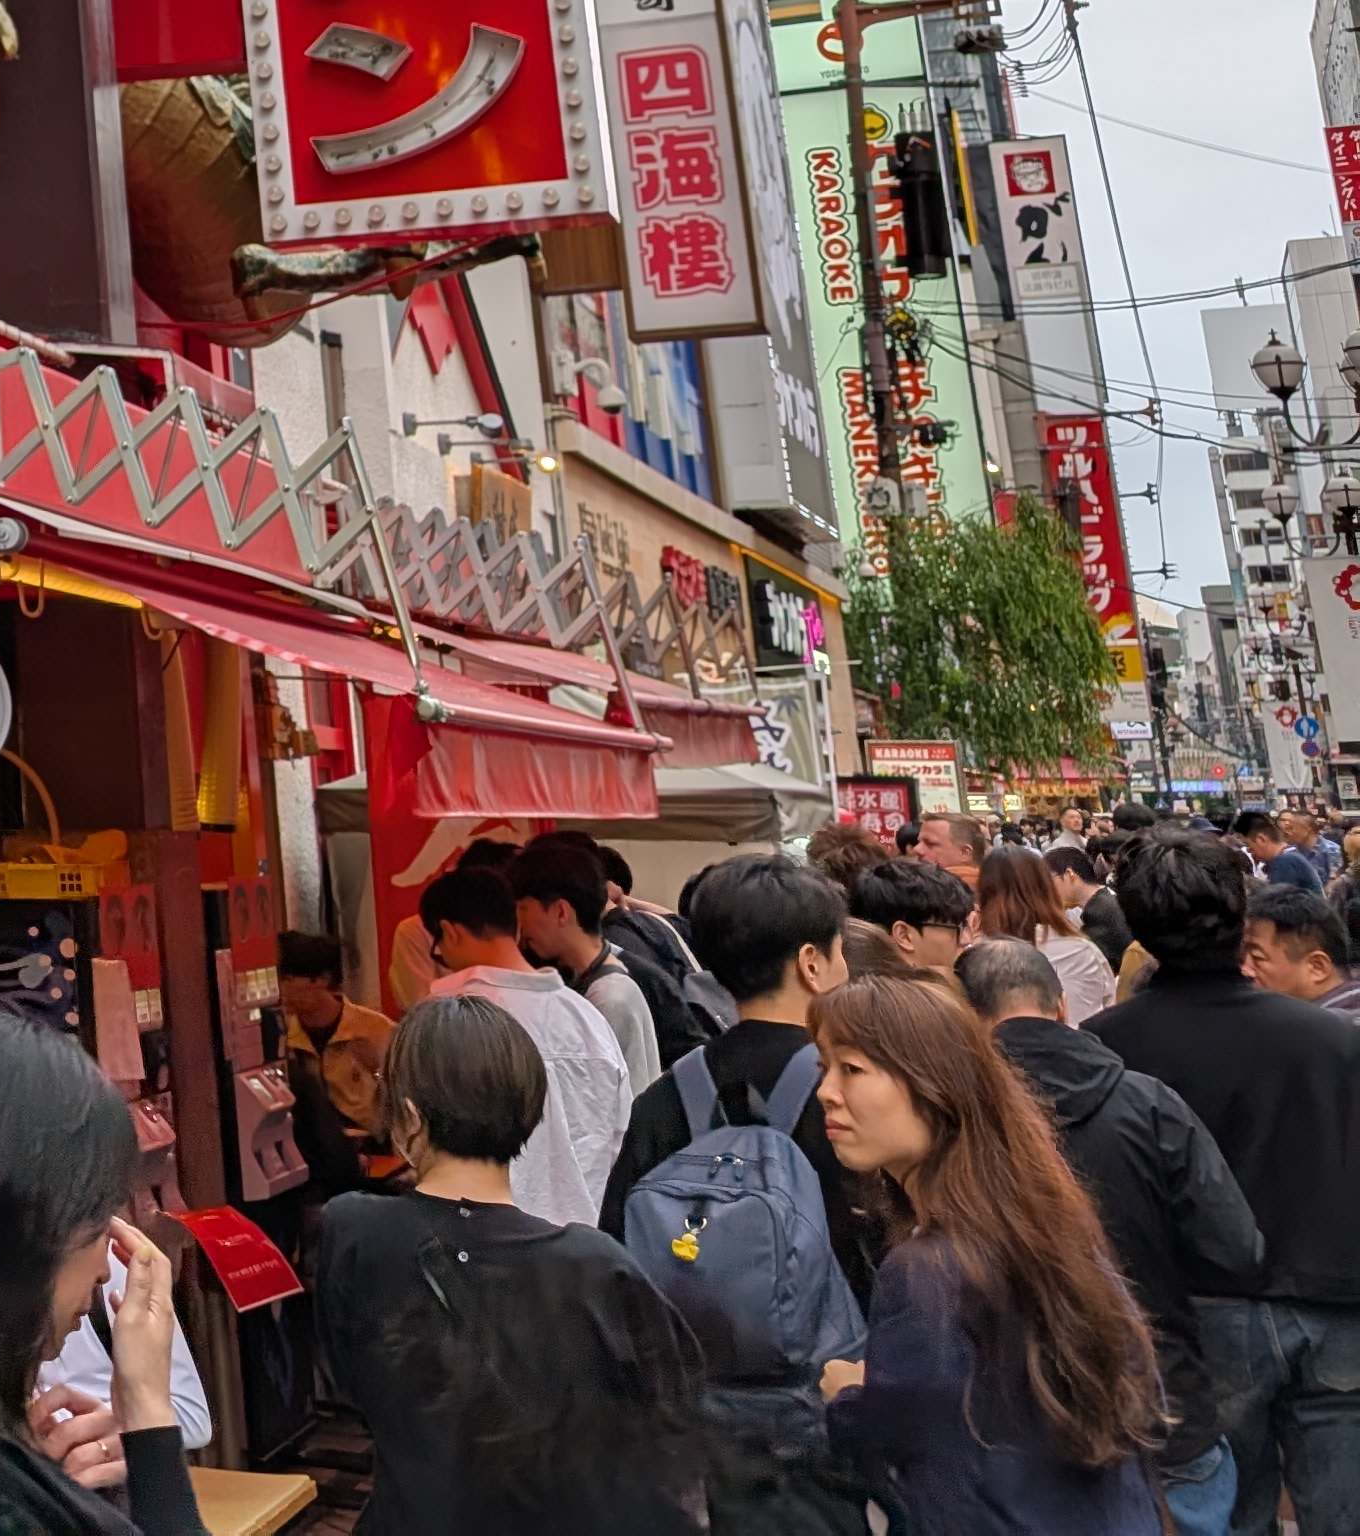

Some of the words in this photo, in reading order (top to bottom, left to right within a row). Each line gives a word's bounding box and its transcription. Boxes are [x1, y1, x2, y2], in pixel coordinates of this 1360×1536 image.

[616, 43, 736, 299] 四海樓
[810, 150, 856, 302] KARAOKE
[841, 371, 891, 575] MANEKEKO
[874, 747, 929, 760] KARAOKE
[890, 764, 943, 776] ジャンカラ
